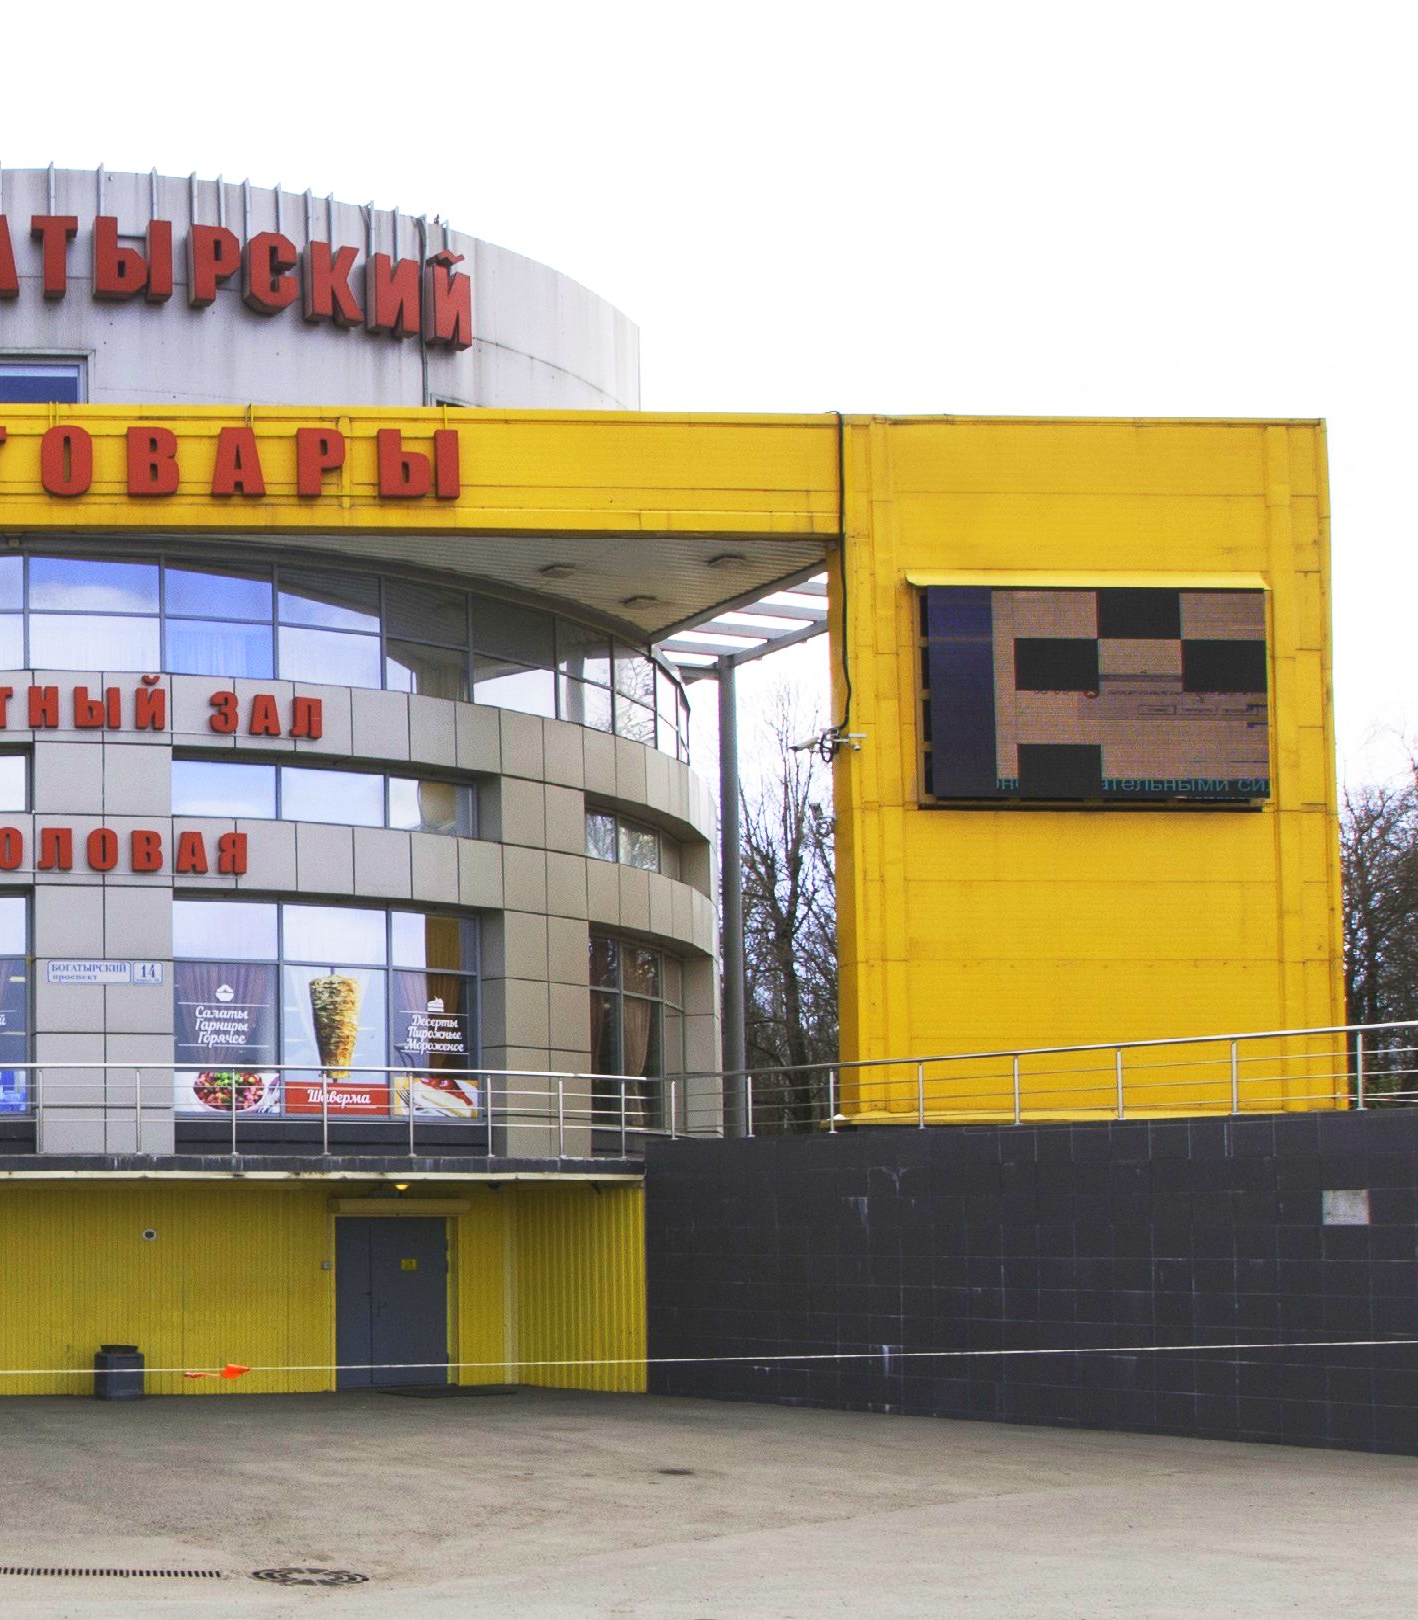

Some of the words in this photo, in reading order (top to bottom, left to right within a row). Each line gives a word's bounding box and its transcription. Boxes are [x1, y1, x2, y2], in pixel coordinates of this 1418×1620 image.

[209, 690, 322, 739] ЗАЛ
[1237, 778, 1270, 792] си
[51, 963, 127, 973] БОГАТЫРСКИЙ
[141, 964, 155, 978] 14
[52, 974, 98, 982] проспект
[195, 1005, 249, 1020] Салаты
[195, 1018, 249, 1037] Гарниры
[411, 1014, 459, 1031] Десерты
[197, 1031, 247, 1049] Горячее
[407, 1026, 463, 1043] Пирожные
[405, 1038, 465, 1055] Мороженое
